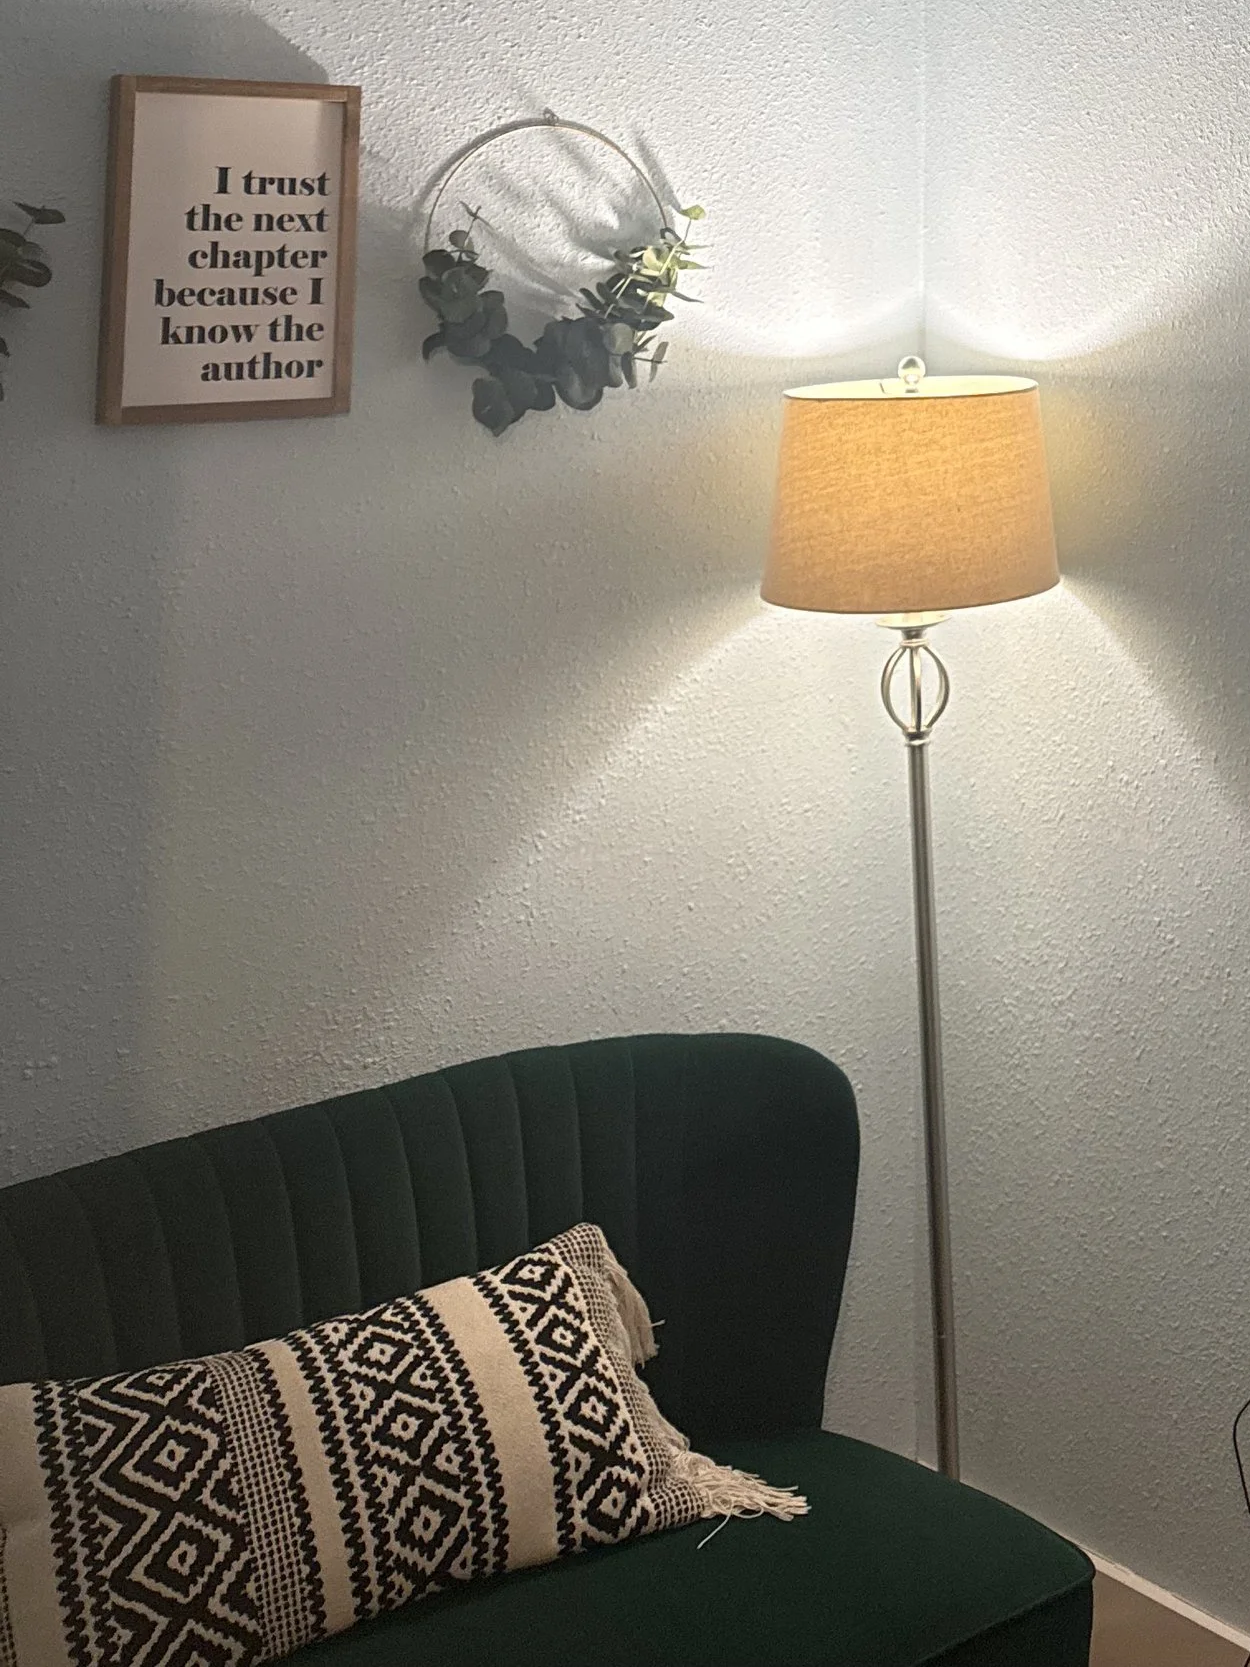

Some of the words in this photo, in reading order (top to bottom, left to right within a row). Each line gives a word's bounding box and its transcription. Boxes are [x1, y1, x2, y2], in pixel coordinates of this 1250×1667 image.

[214, 166, 232, 195] I
[242, 170, 330, 196] trust
[185, 203, 243, 232] the
[252, 207, 329, 232] next
[187, 240, 328, 278] chapter
[153, 278, 298, 307] because
[307, 277, 324, 305] I
[160, 316, 260, 345] know
[268, 314, 325, 343] the
[200, 351, 323, 382] author
